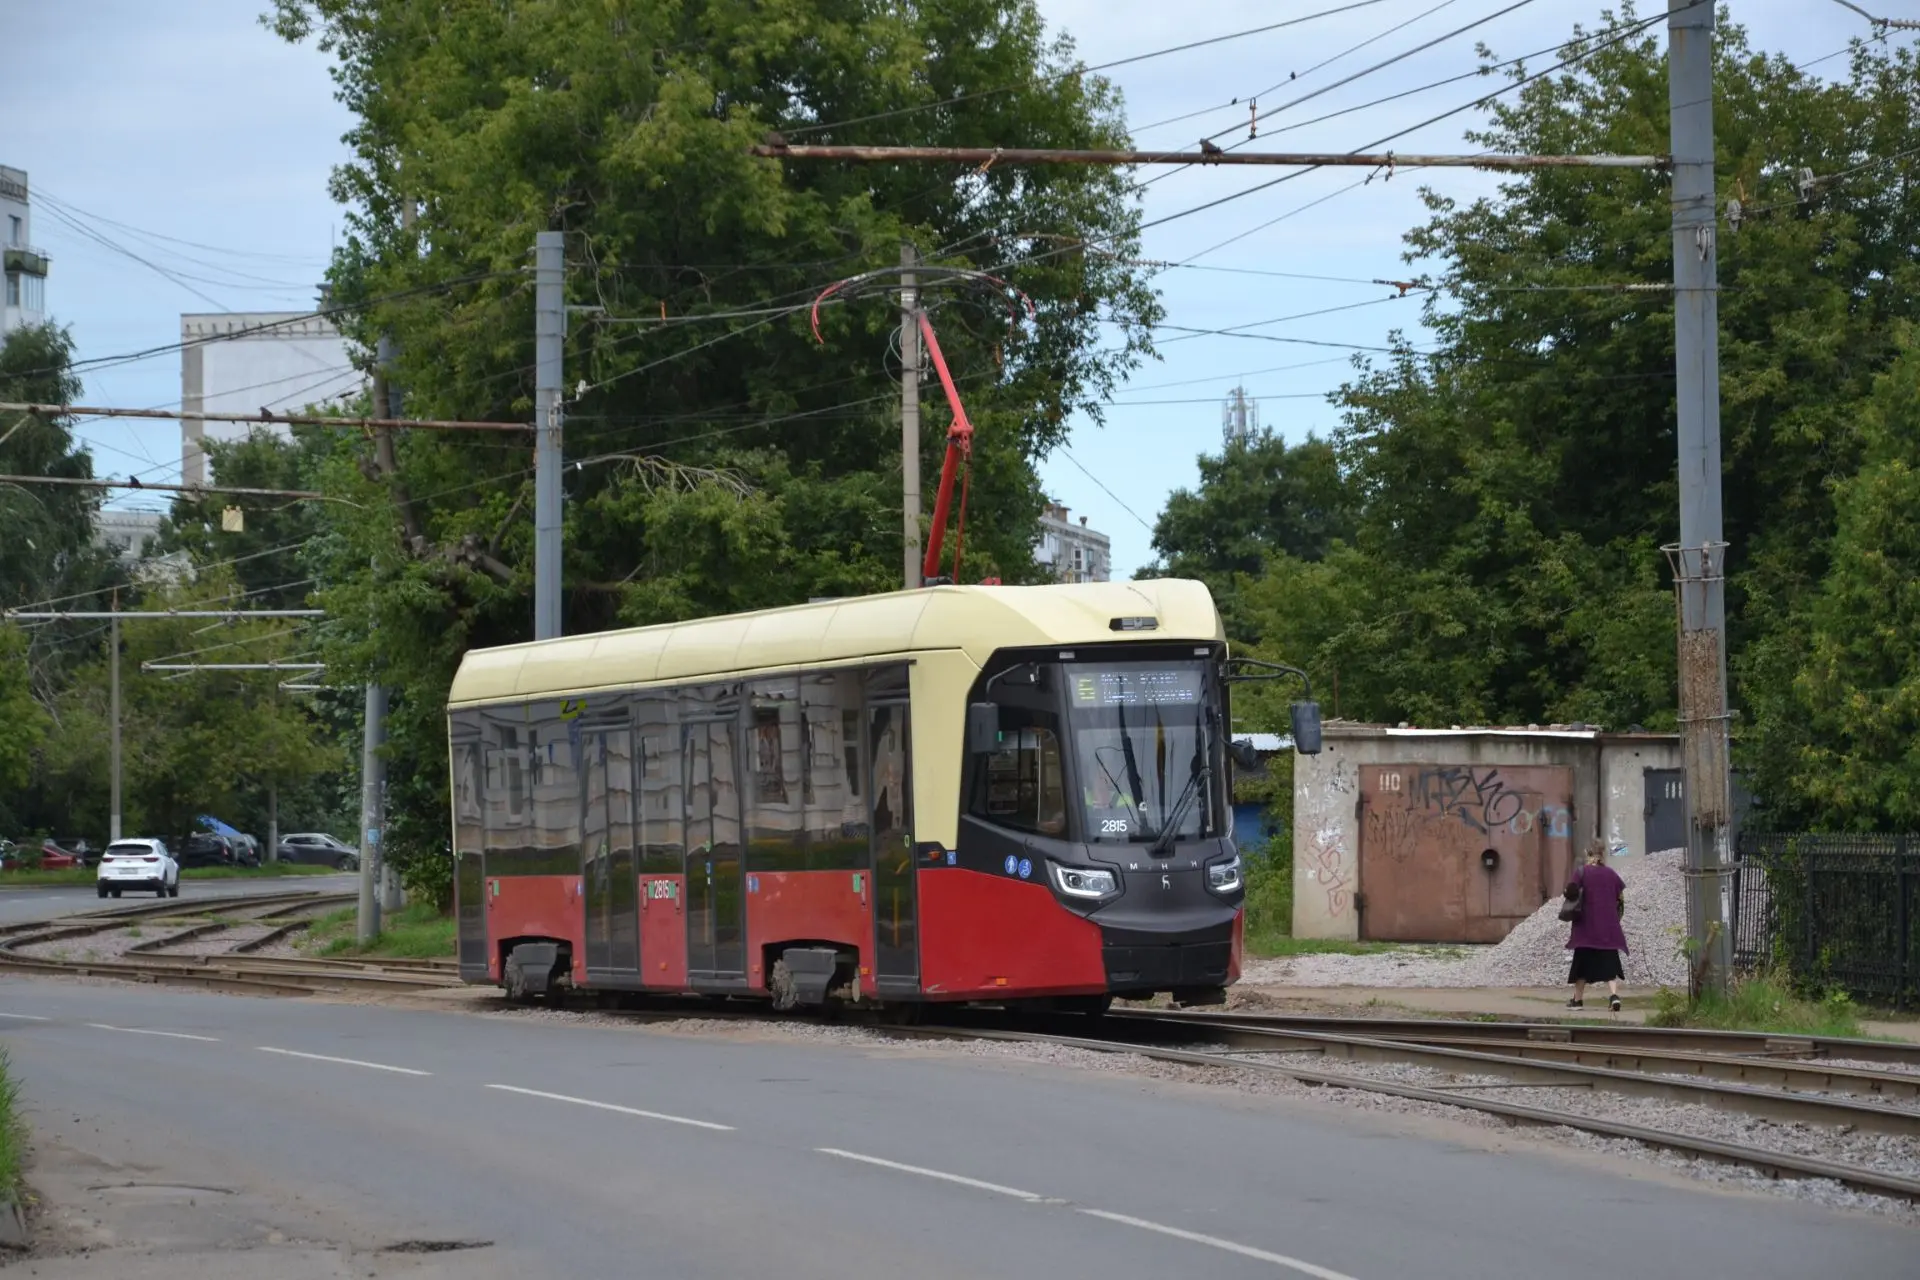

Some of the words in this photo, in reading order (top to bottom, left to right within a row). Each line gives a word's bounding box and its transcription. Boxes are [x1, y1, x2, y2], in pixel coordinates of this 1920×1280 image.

[1379, 773, 1401, 791] 110
[1101, 819, 1128, 832] 2815
[654, 880, 670, 899] 2815
